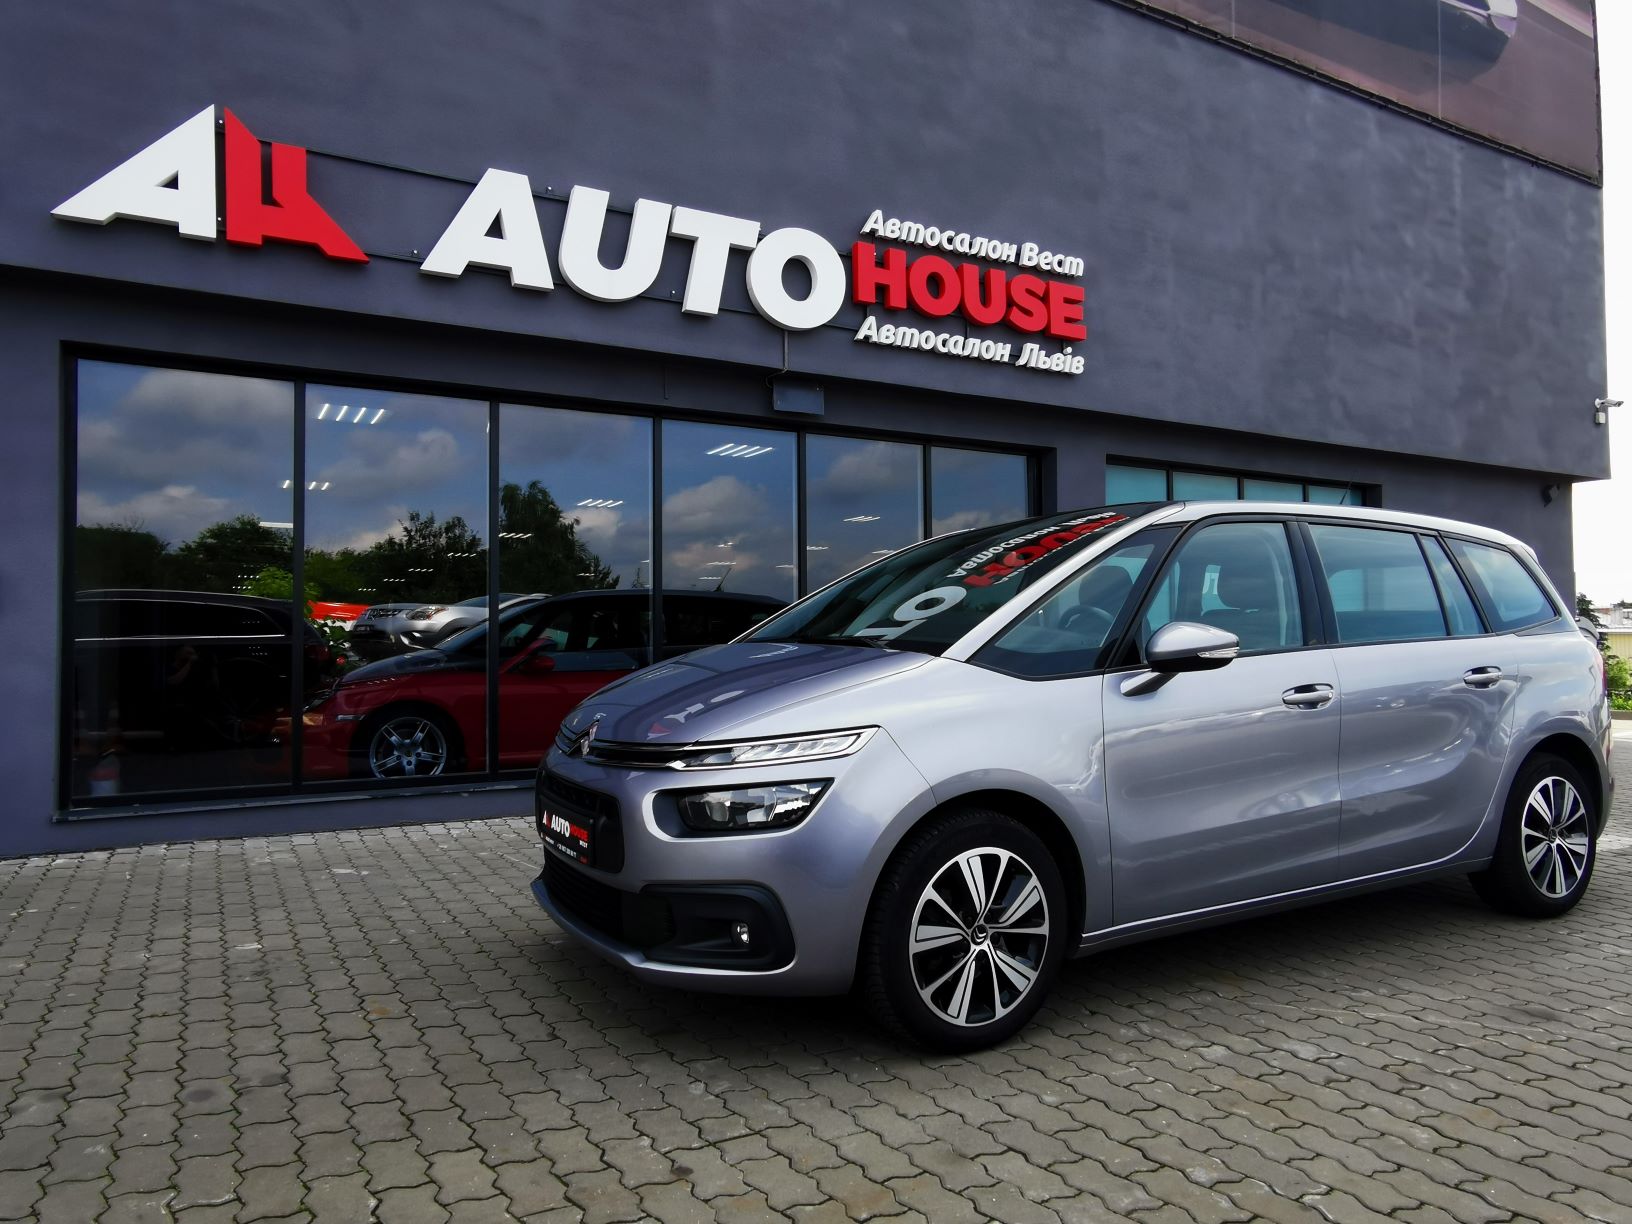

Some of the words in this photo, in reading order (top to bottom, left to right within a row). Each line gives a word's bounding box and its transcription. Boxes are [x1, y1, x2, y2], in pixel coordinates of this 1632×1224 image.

[419, 168, 847, 331] AUTO
[853, 241, 1086, 341] HOUSE
[860, 209, 1017, 263] Автосалон
[1019, 242, 1084, 277] Вест
[854, 315, 1012, 363] Автосалон
[1015, 342, 1085, 375] Львів
[550, 814, 570, 838] AUTO
